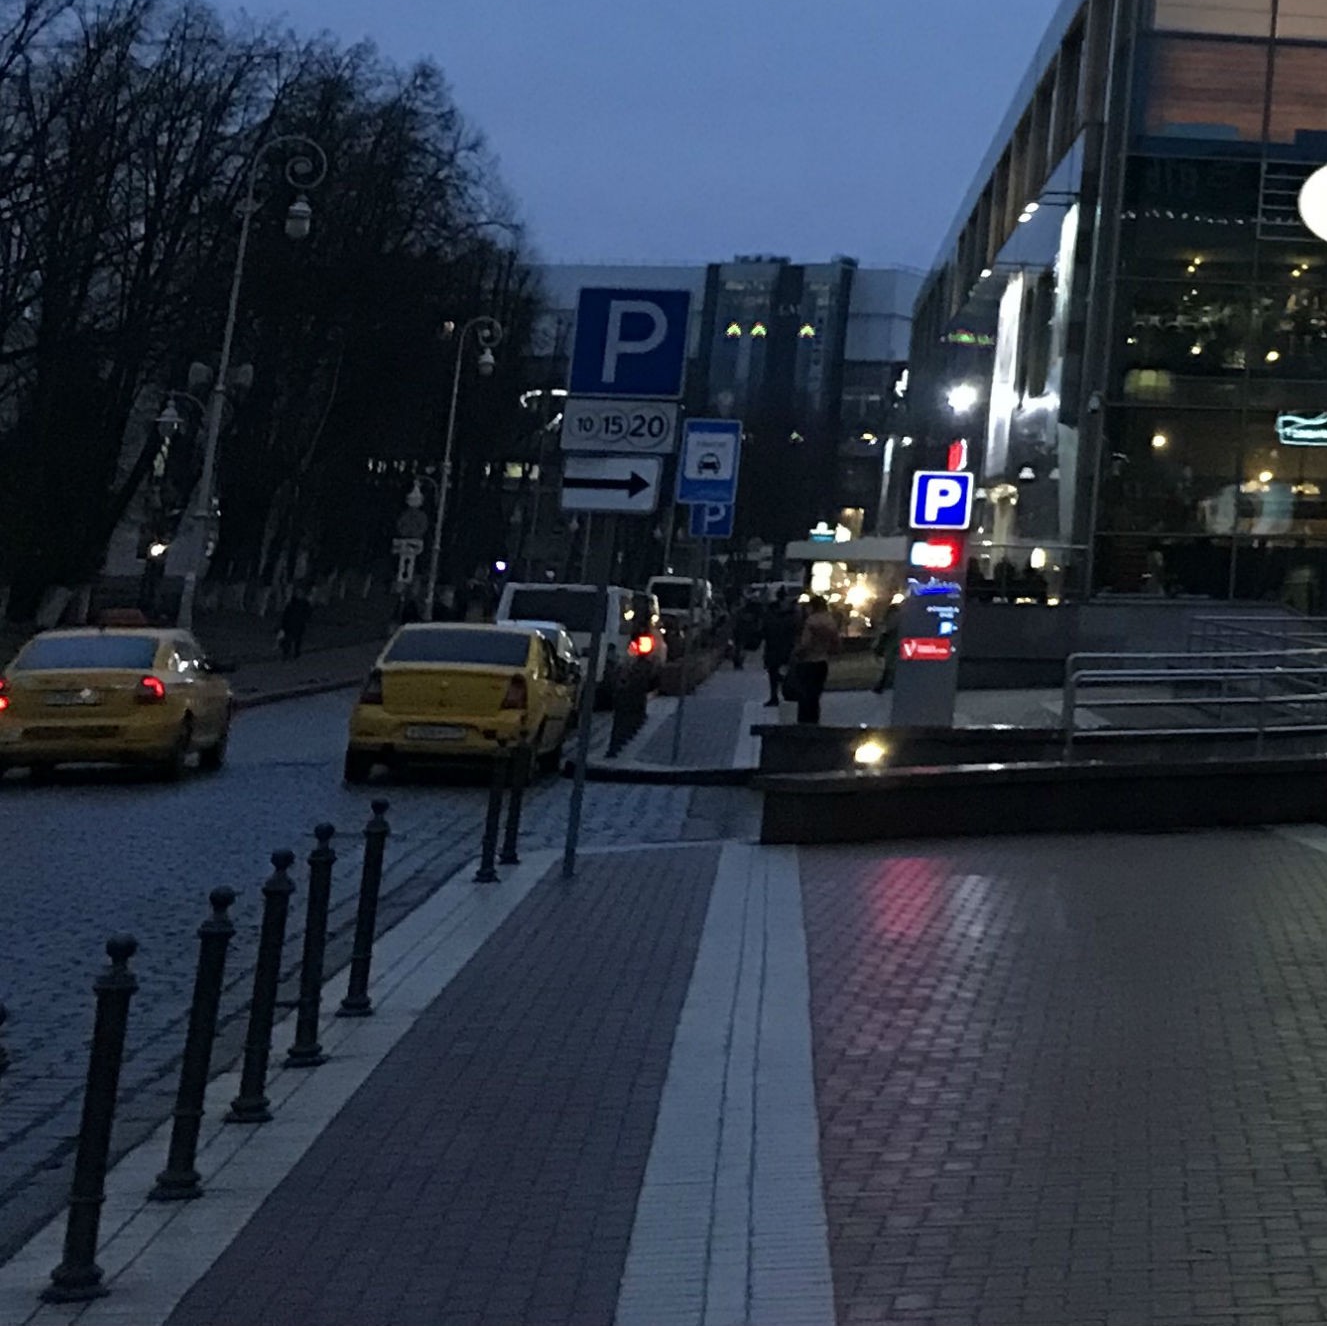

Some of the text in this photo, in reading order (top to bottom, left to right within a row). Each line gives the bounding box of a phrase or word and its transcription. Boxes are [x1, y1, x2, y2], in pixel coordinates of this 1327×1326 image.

[601, 299, 669, 383] P
[576, 414, 664, 437] 10 15 20
[924, 478, 963, 522] P
